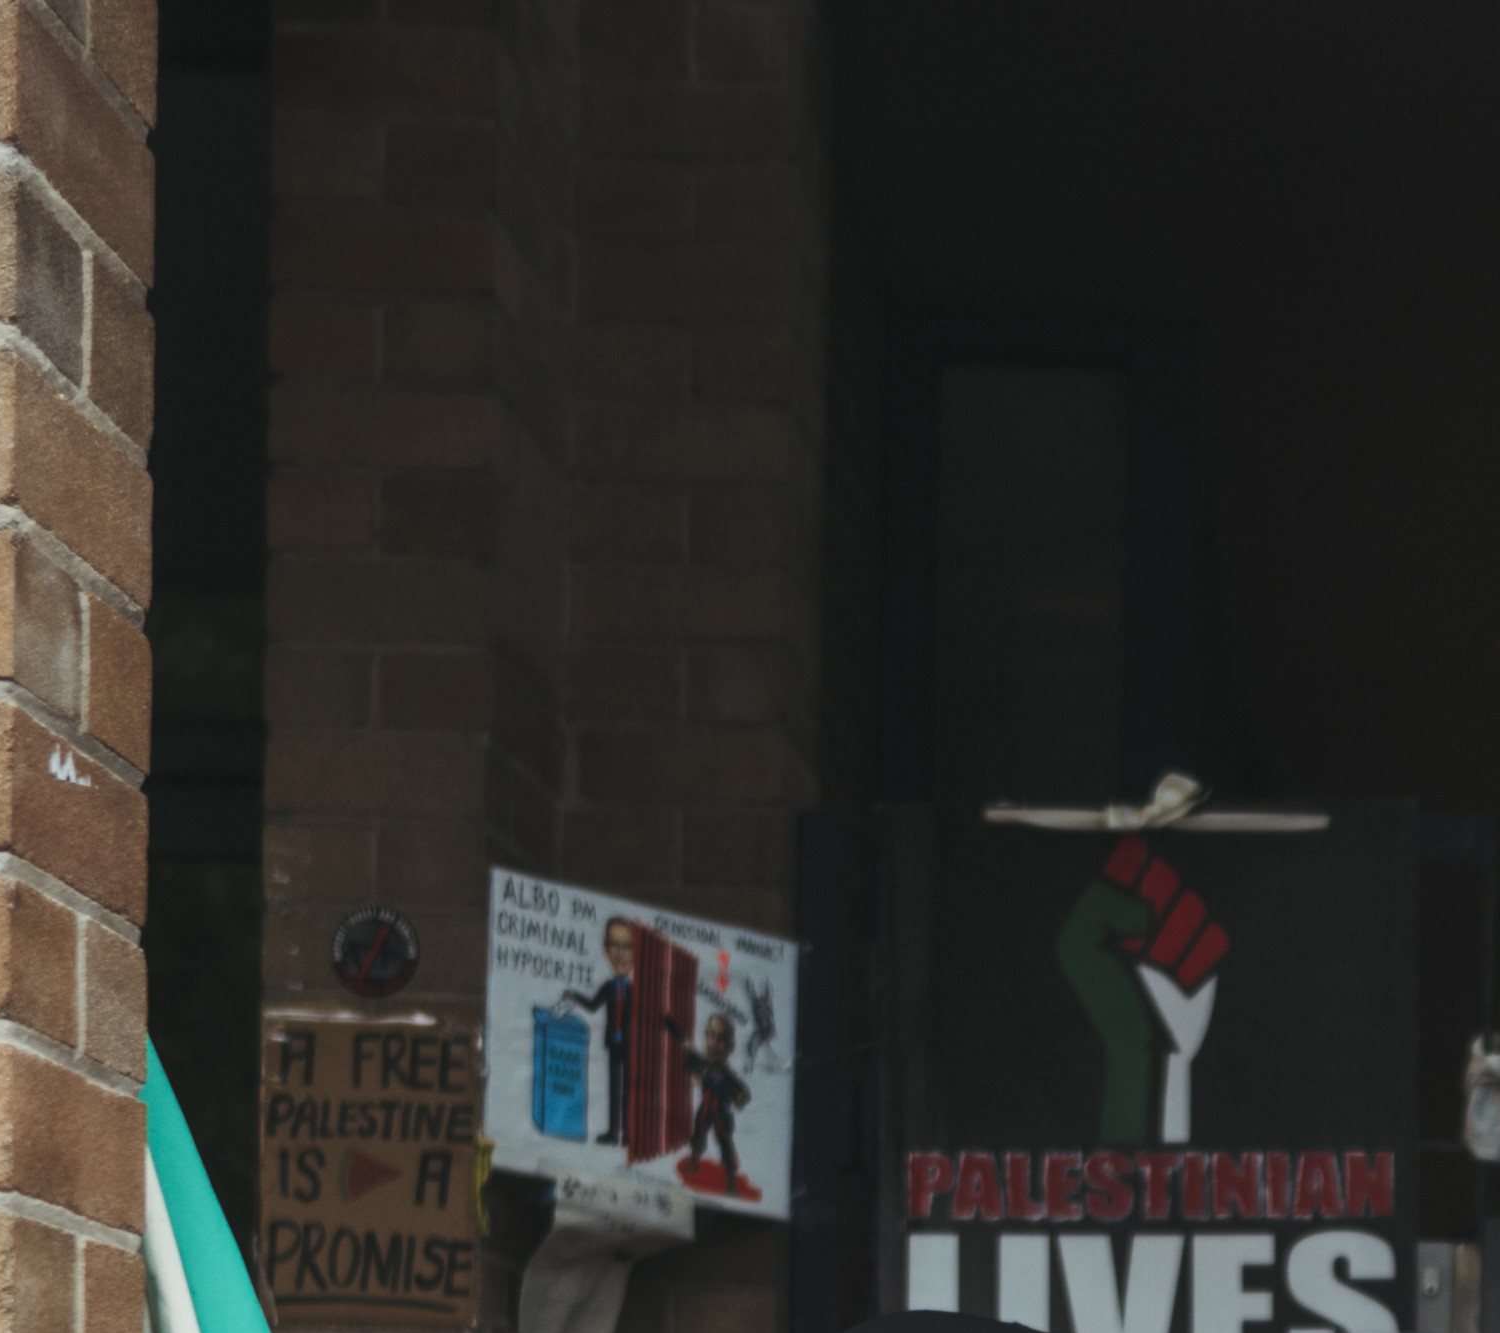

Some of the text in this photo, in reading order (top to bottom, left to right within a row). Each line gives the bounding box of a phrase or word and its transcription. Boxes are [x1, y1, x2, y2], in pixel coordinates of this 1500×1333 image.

[503, 876, 598, 925] ALBO PM
[497, 909, 588, 957] CRIMINAL
[496, 945, 596, 990] HYPOCRITE
[280, 1031, 470, 1092] A FREE
[266, 1093, 474, 1143] PALESTINE
[278, 1150, 453, 1209] IS A
[907, 1150, 1396, 1221] PALESTINIAN
[267, 1219, 475, 1297] PROMISE
